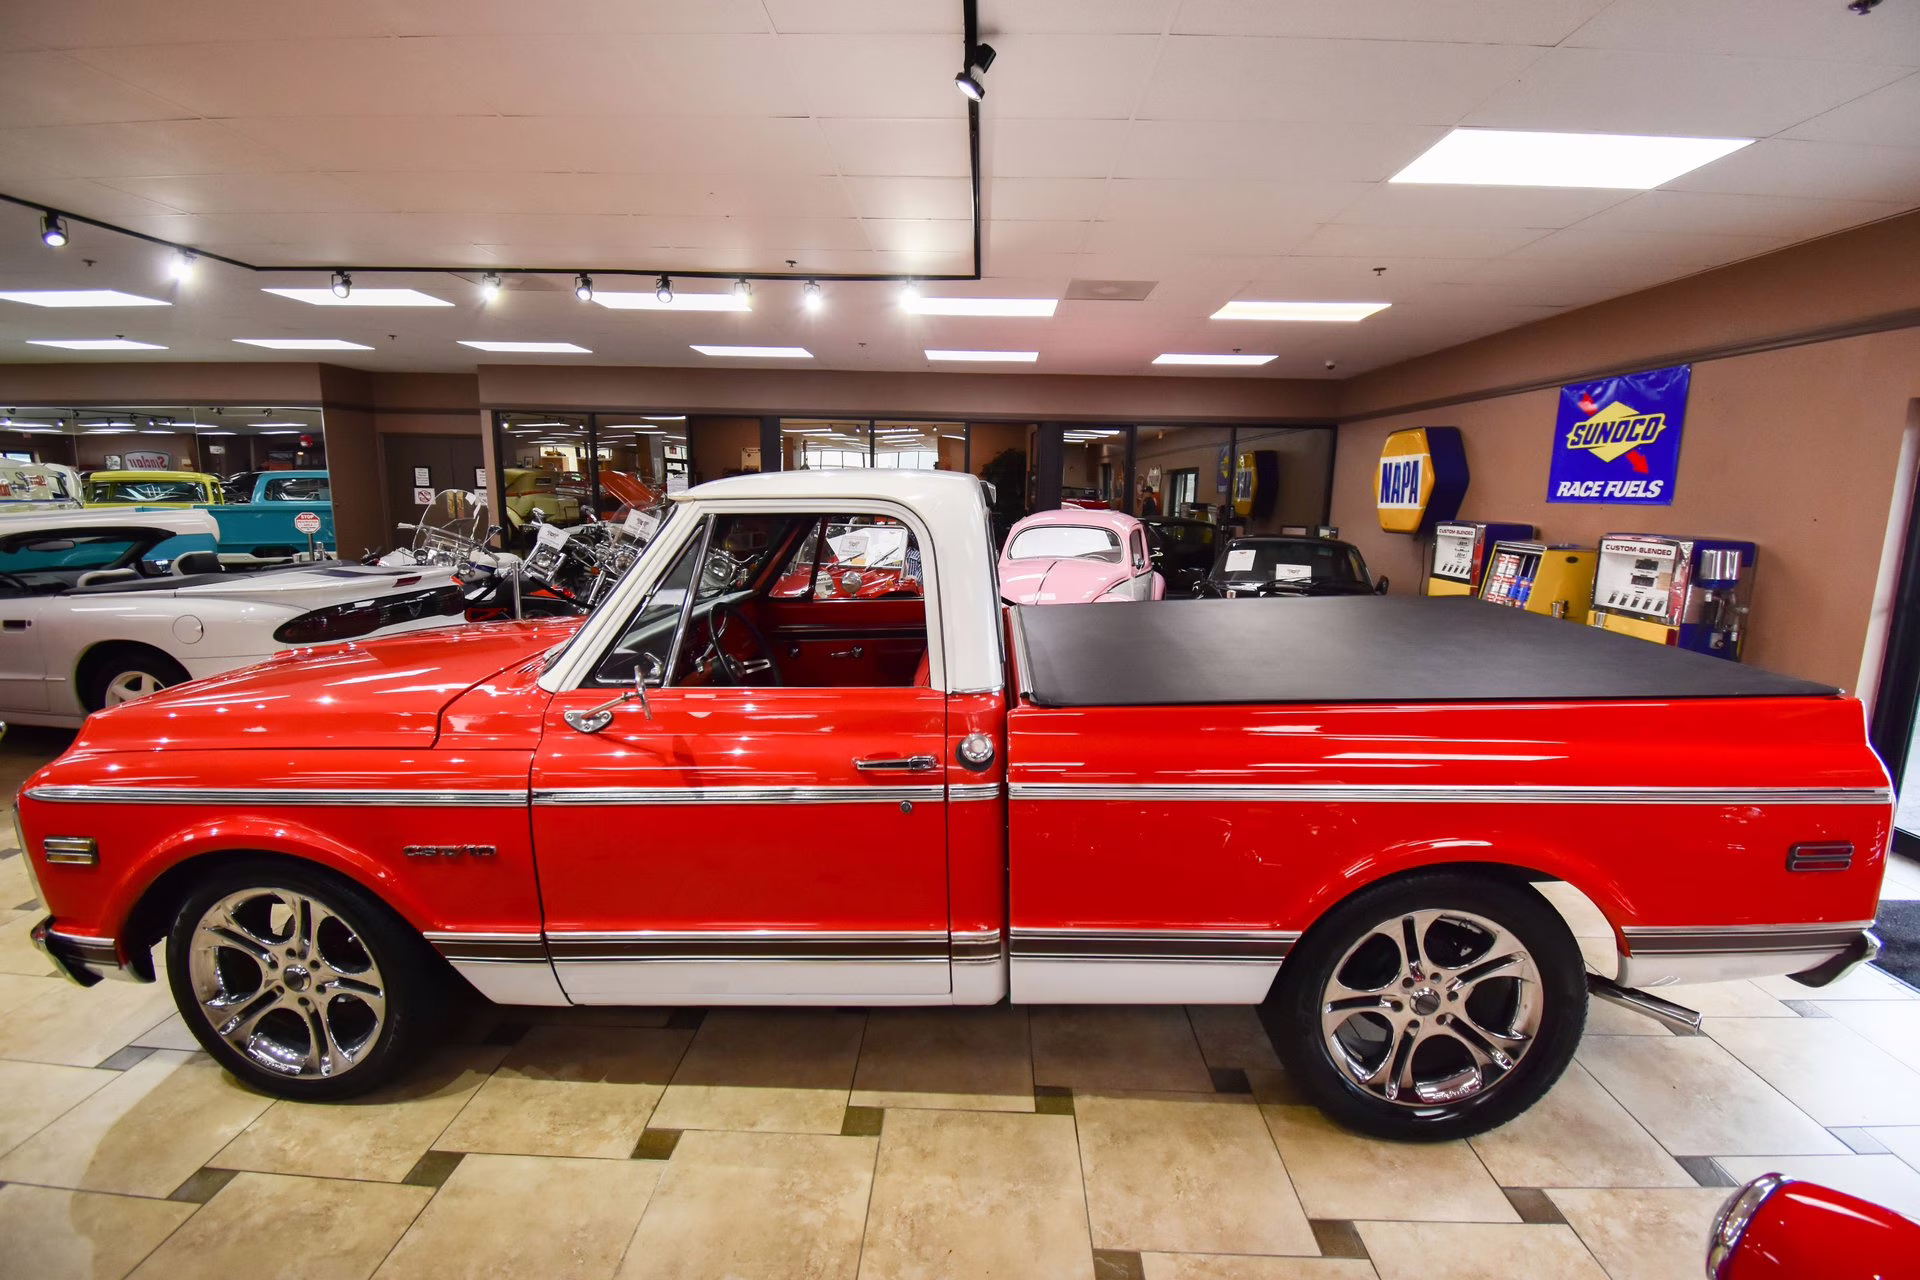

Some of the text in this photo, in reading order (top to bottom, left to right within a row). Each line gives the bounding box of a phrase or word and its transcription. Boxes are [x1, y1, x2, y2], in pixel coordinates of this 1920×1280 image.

[1569, 416, 1662, 446] SUNOCO
[1380, 460, 1419, 504] NAPA
[1556, 480, 1664, 498] RACE FUELS
[1438, 528, 1474, 536] CUSTOM-BLENDED
[1605, 544, 1672, 556] CUSTOM-BLENDED
